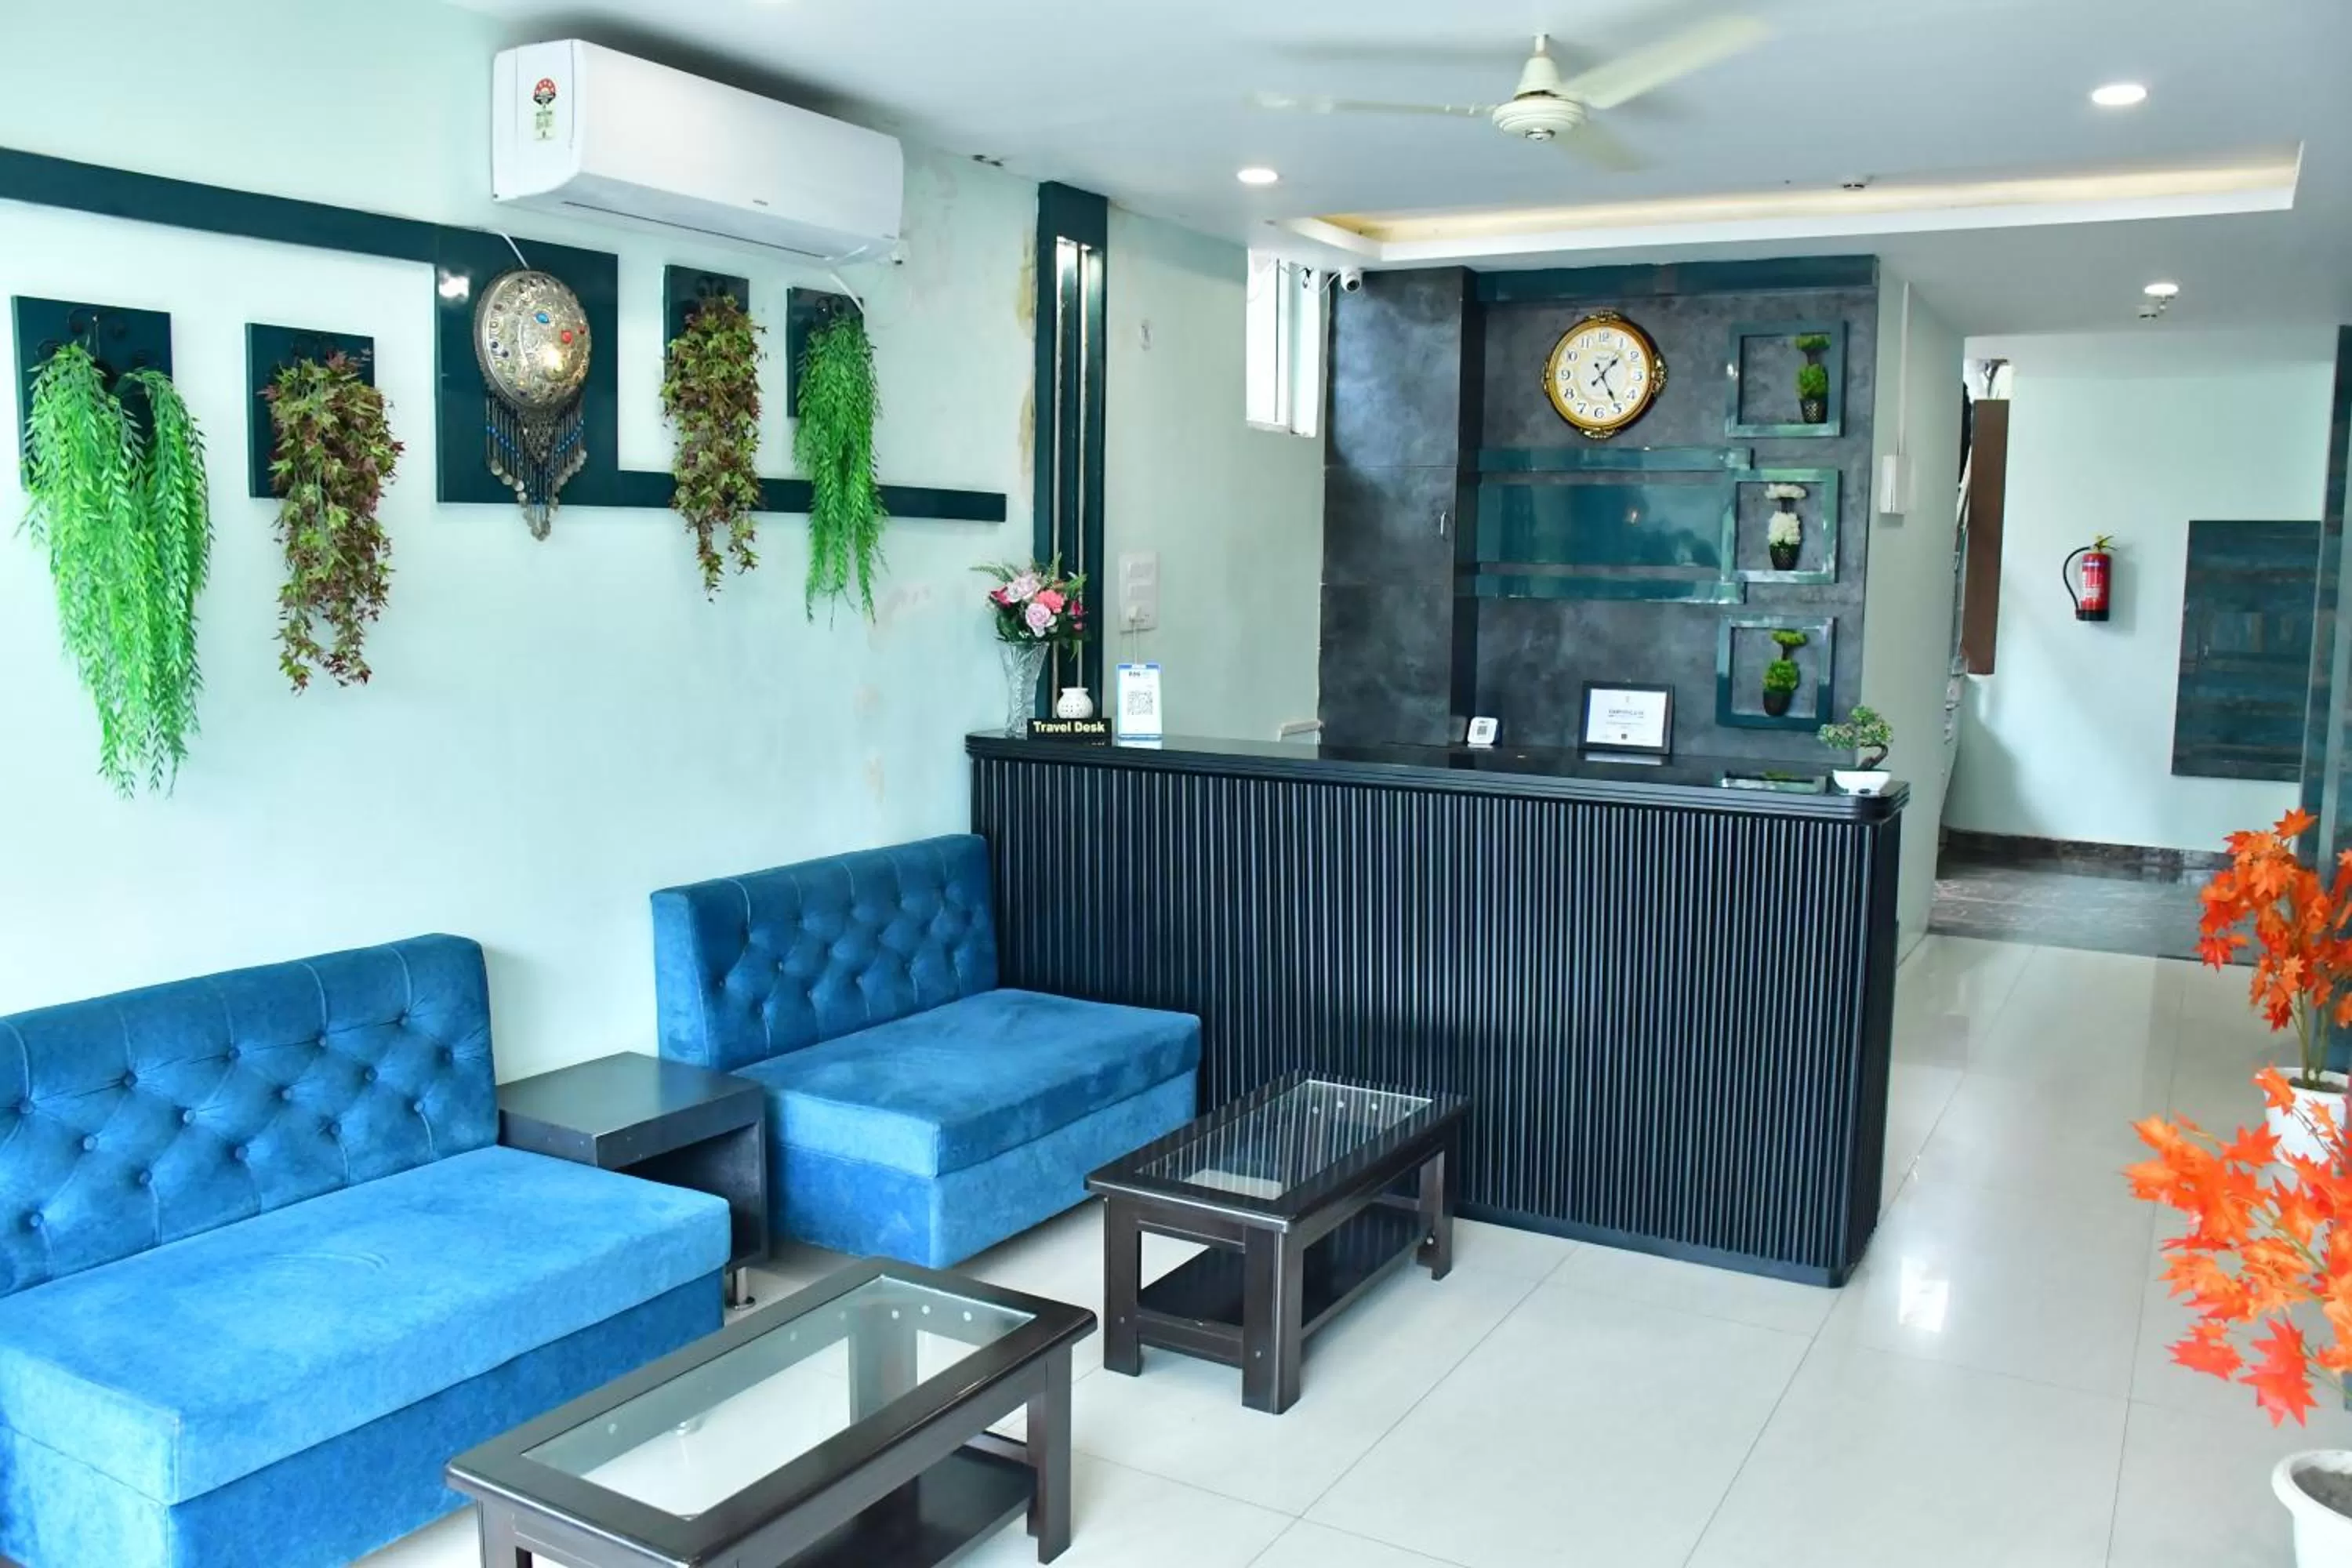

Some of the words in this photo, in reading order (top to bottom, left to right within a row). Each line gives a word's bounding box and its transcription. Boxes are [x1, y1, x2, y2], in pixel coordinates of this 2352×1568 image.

[1599, 332, 1610, 343] 12
[1581, 338, 1589, 349] 11
[1567, 350, 1578, 361] 10
[1630, 350, 1639, 361] 2
[1561, 369, 1570, 380] 9
[1633, 370, 1642, 381] 3
[1564, 389, 1574, 399] 8
[1627, 389, 1635, 400] 4
[1577, 402, 1586, 413] 7
[1594, 407, 1605, 419] 6
[1613, 402, 1622, 414] 5
[1033, 720, 1072, 733] Travel
[1074, 720, 1105, 733] Desk
